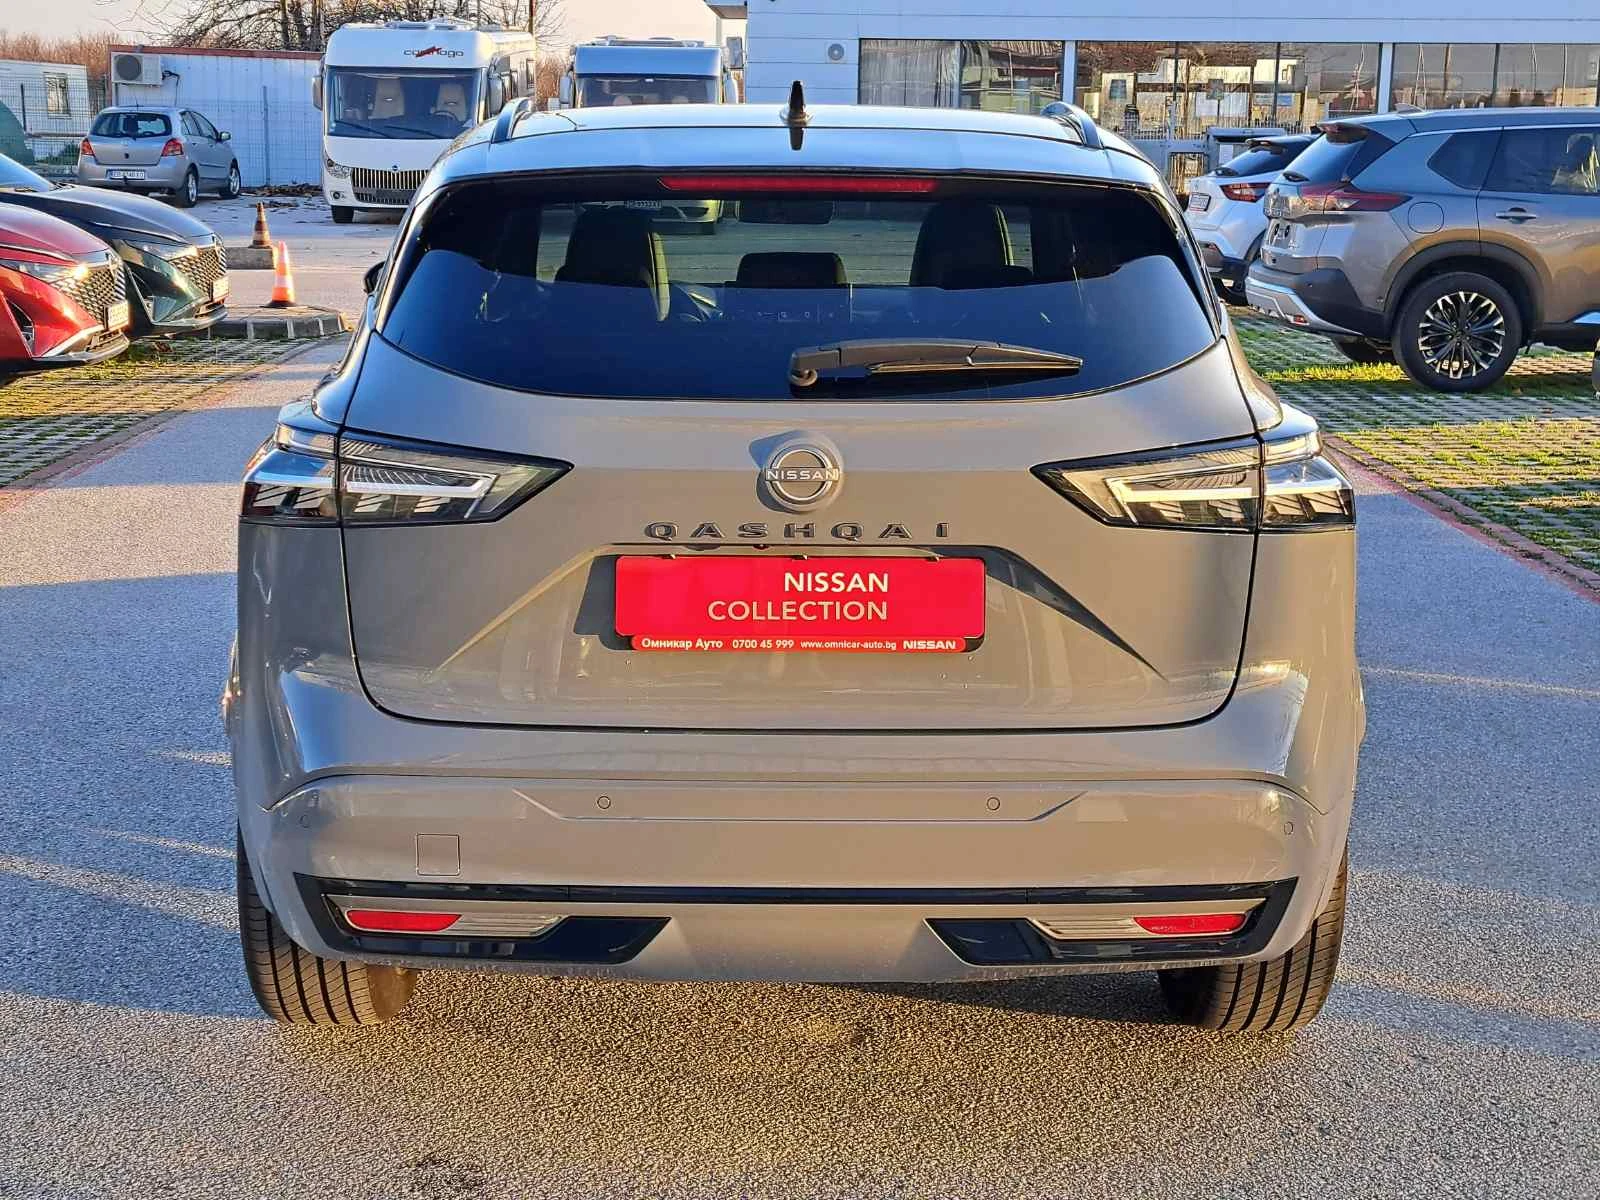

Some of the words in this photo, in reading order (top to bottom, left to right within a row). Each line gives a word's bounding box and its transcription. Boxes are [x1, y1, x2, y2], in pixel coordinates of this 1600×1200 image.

[766, 469, 838, 481] NISSAN
[645, 521, 949, 541] QASHQAI
[784, 572, 889, 592] NISSAN
[707, 600, 888, 621] COLLECTION
[641, 638, 693, 649] Омникар
[695, 638, 724, 650] Ауто
[732, 639, 758, 649] 0700
[760, 639, 773, 649] 45
[775, 639, 795, 649] 999
[800, 640, 897, 650] www.omnicar-auto.bg
[903, 640, 956, 649] NISSAN
